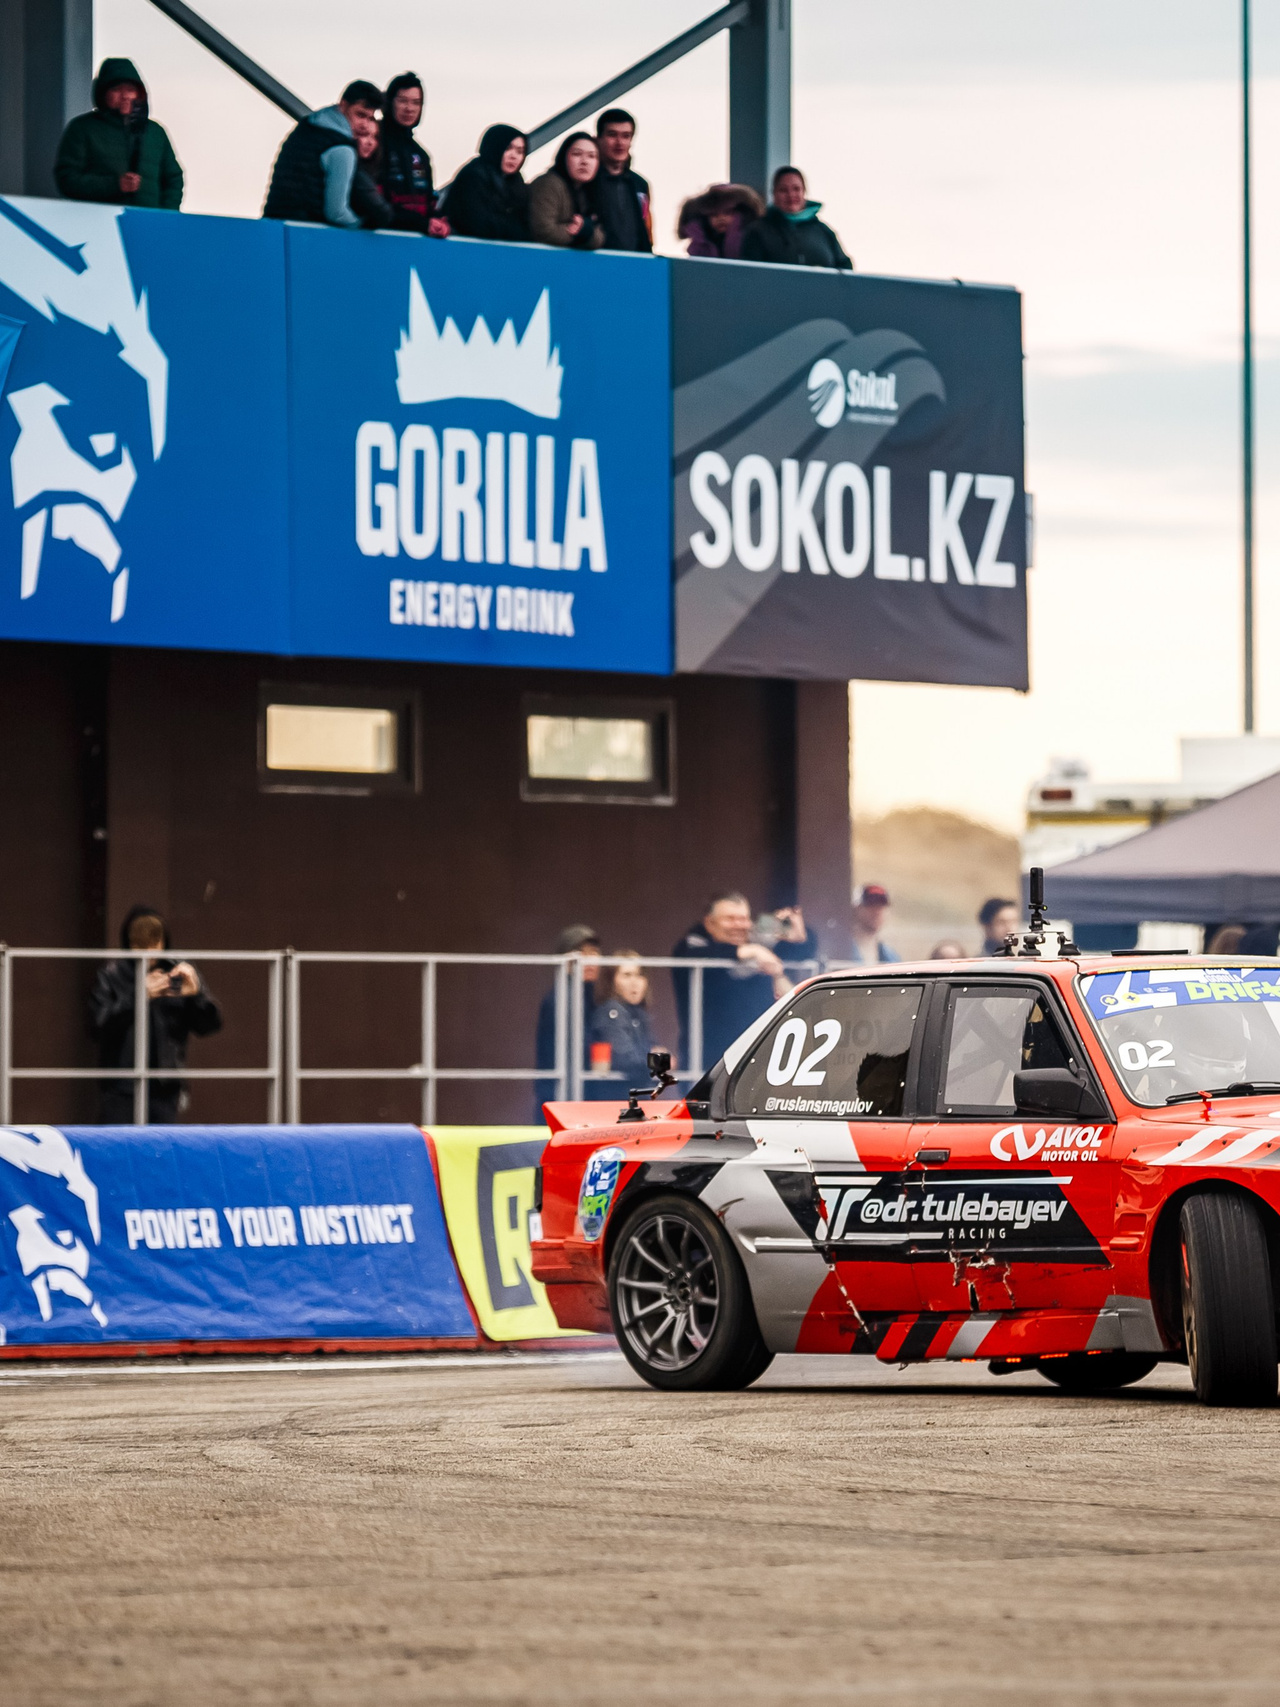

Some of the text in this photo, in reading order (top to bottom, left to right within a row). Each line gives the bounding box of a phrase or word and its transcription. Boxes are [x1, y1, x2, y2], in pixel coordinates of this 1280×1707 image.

[355, 420, 608, 573] GORILLA
[689, 451, 1016, 588] SOKOL.KZ
[389, 578, 575, 638] ENERGY DRINK
[764, 1017, 842, 1087] 02
[1117, 1039, 1176, 1071] 02
[1040, 1150, 1099, 1162] MOTOR OIL
[1044, 1126, 1104, 1148] AVOL
[125, 1203, 416, 1250] POWER YOUR INSTINCT
[860, 1193, 1068, 1230] @dr.tulebayev
[948, 1227, 1007, 1240] RACING
